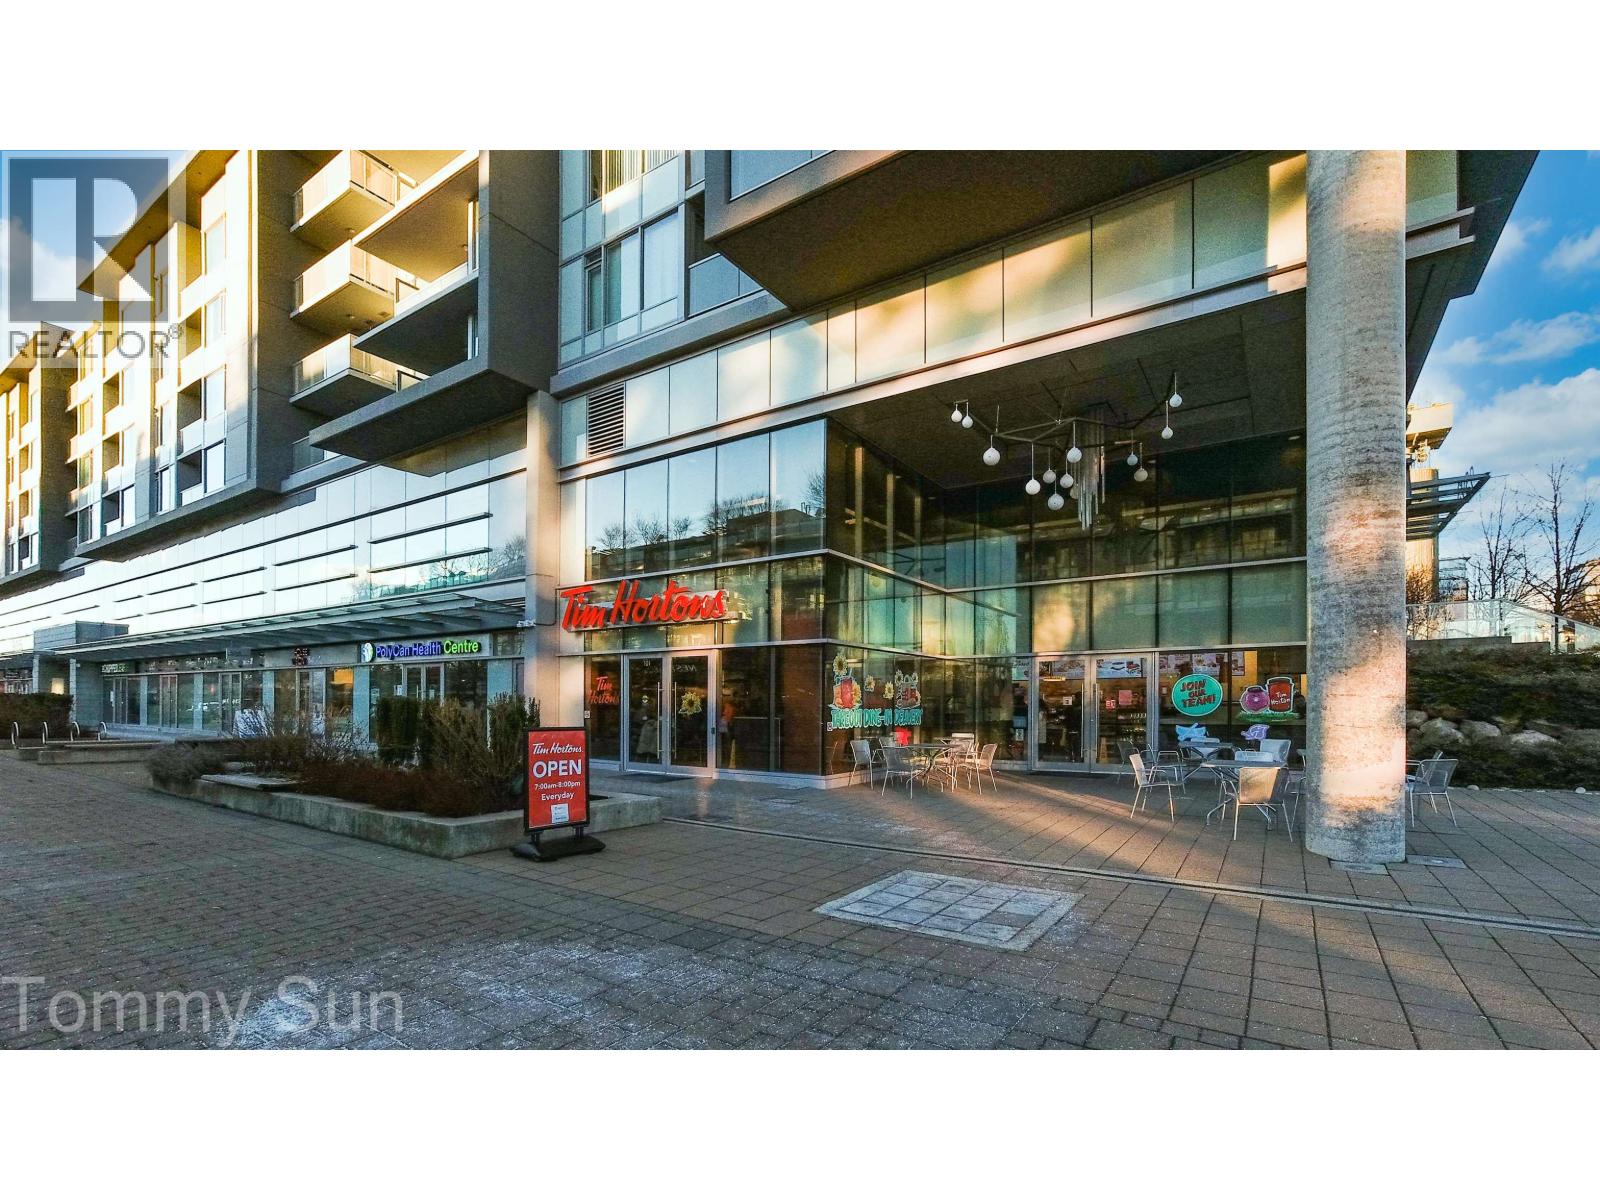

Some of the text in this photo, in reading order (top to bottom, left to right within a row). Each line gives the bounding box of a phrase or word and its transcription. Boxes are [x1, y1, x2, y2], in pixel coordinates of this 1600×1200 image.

[560, 578, 726, 630] Tim Hortons
[375, 639, 480, 660] PolyCan Health Centre
[596, 676, 612, 691] Tim
[1180, 679, 1206, 691] JOIN
[1188, 689, 1205, 698] OUR
[1182, 694, 1216, 708] TEAM!
[831, 708, 863, 729] TAKEOUT
[533, 741, 582, 755] Tim Hortons
[532, 758, 582, 778] OPEN
[541, 791, 575, 801] Everyday
